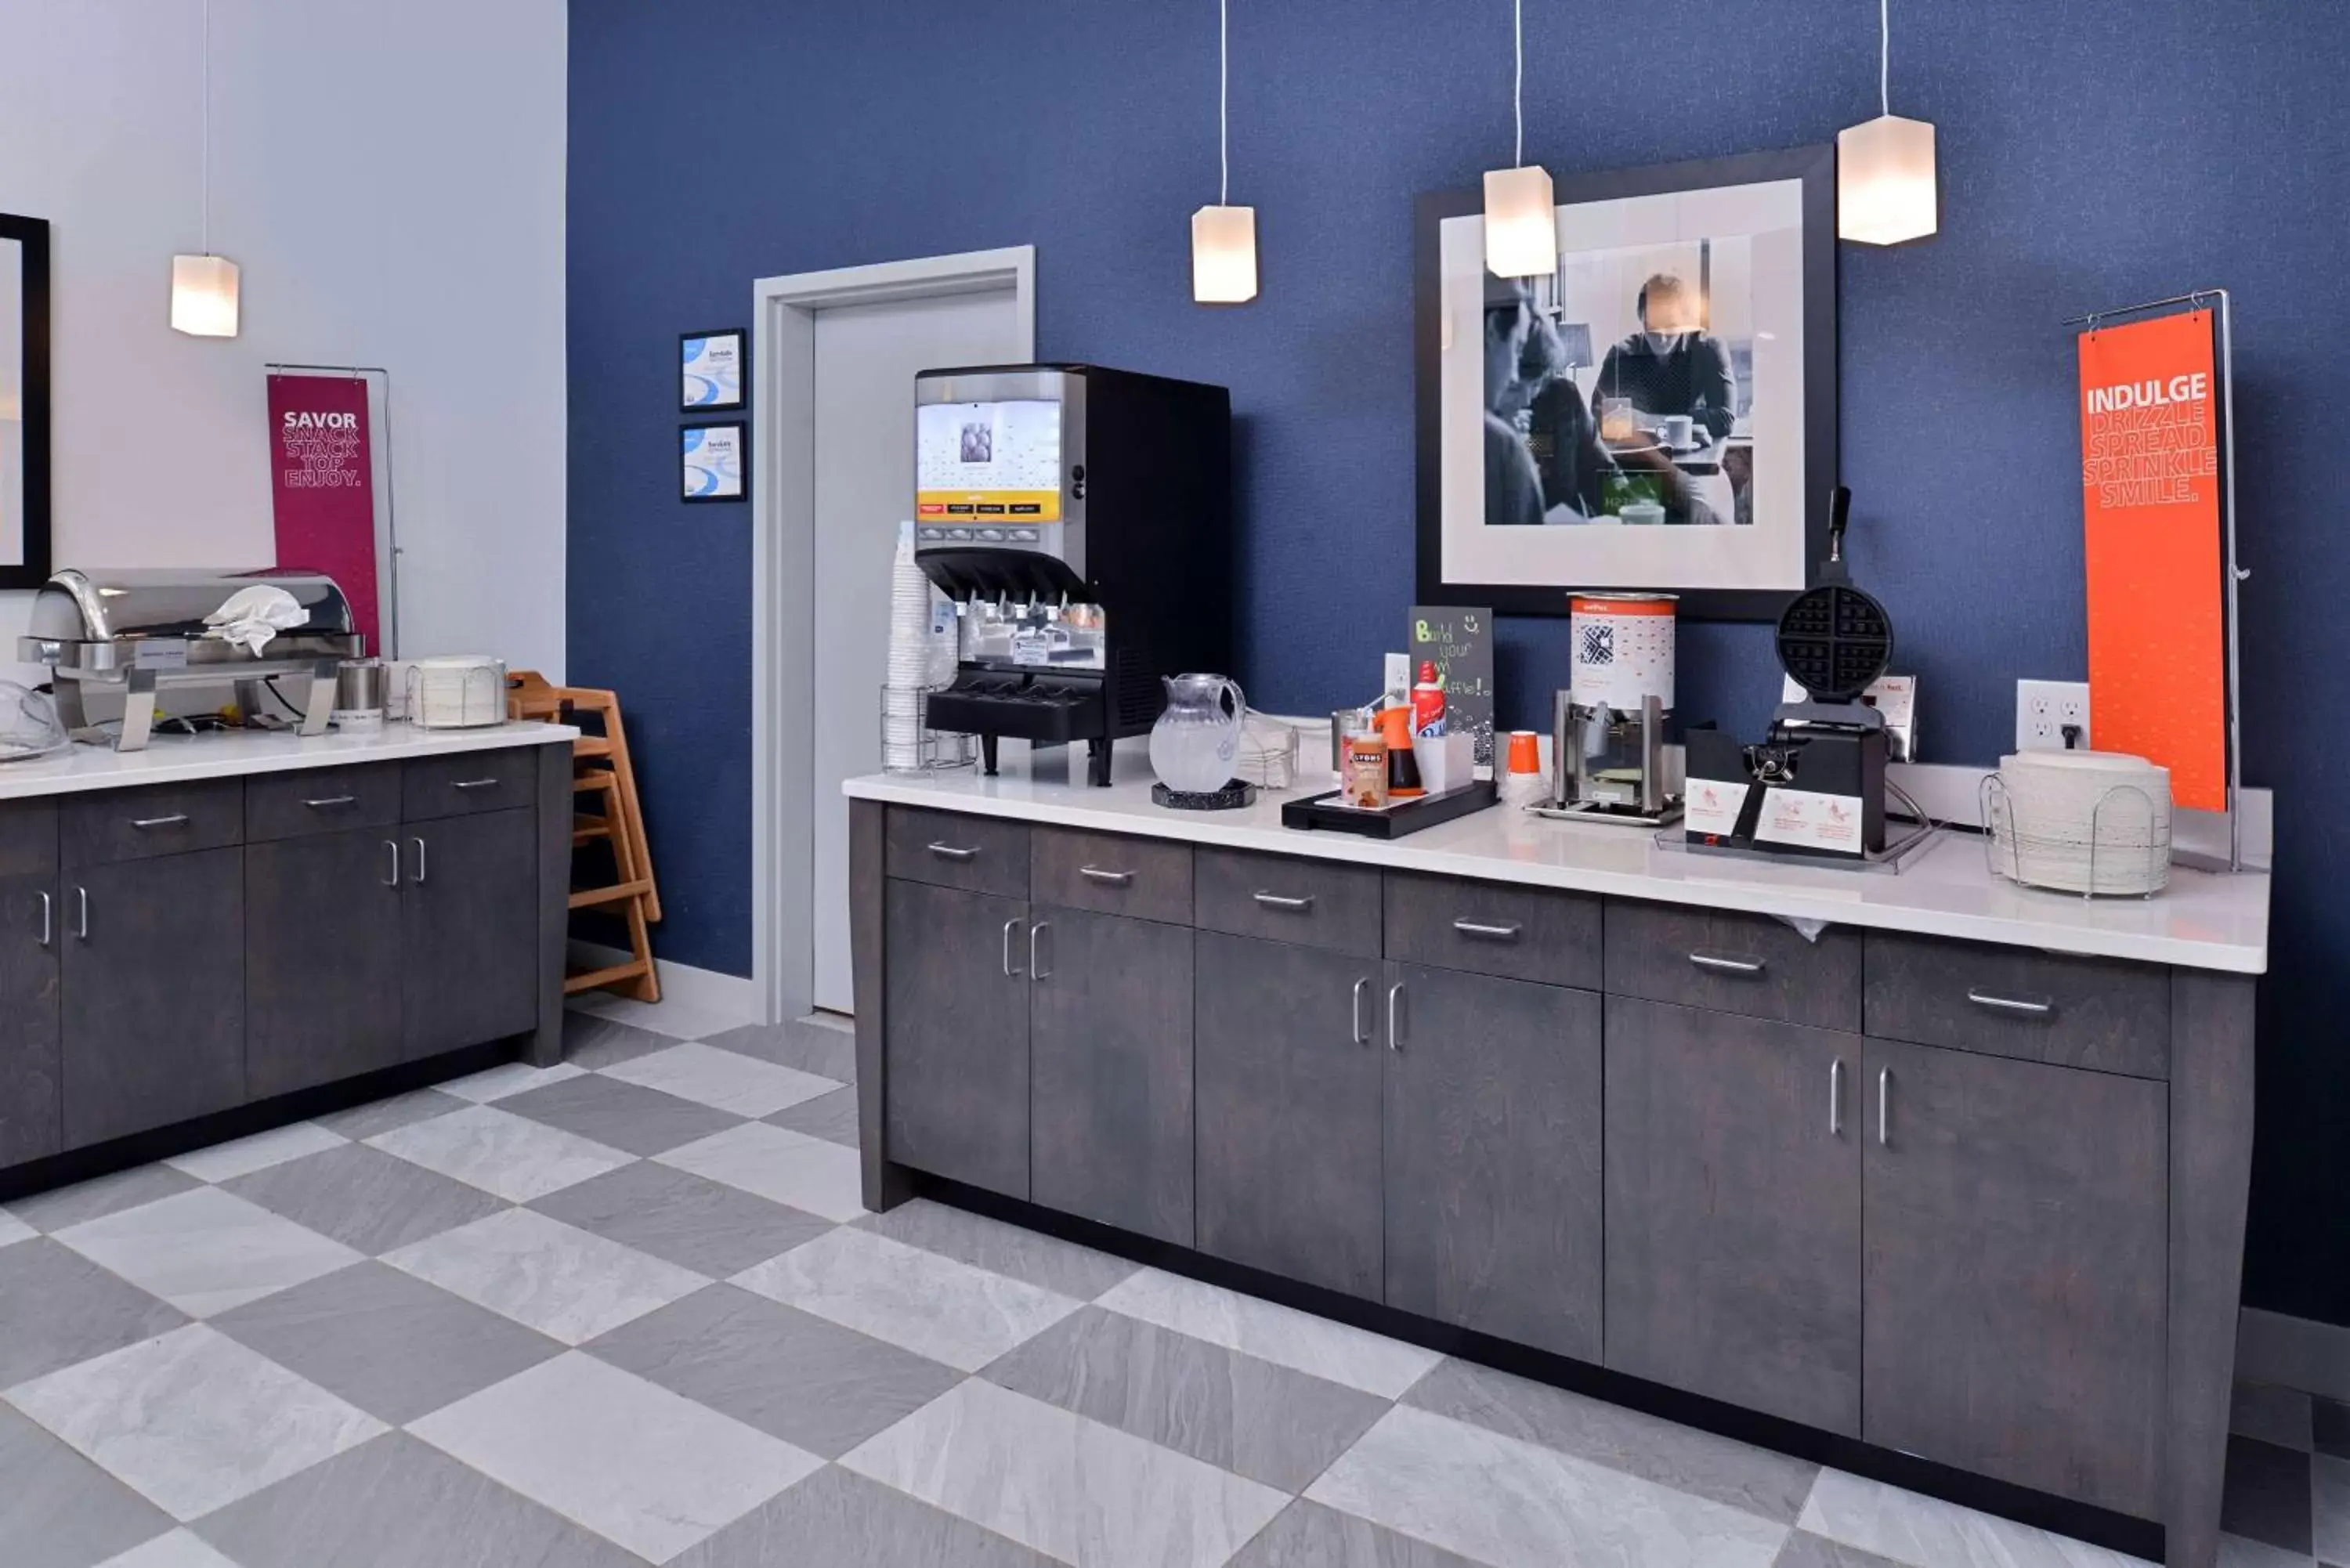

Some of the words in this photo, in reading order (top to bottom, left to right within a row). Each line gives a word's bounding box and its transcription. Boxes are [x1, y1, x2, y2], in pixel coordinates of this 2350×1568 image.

[2088, 372, 2207, 414] INDULGE
[284, 411, 356, 428] SAVOR
[2090, 399, 2205, 435] DRIZZLE
[283, 426, 360, 444] SNACK
[2089, 423, 2207, 460] SPREAD
[285, 441, 359, 458] STACK
[300, 455, 345, 472] TOP
[2082, 445, 2218, 487] SPRINKLE
[284, 469, 362, 488] ENJOY.
[2100, 476, 2200, 509] SMILE.
[1415, 619, 1454, 643] Build
